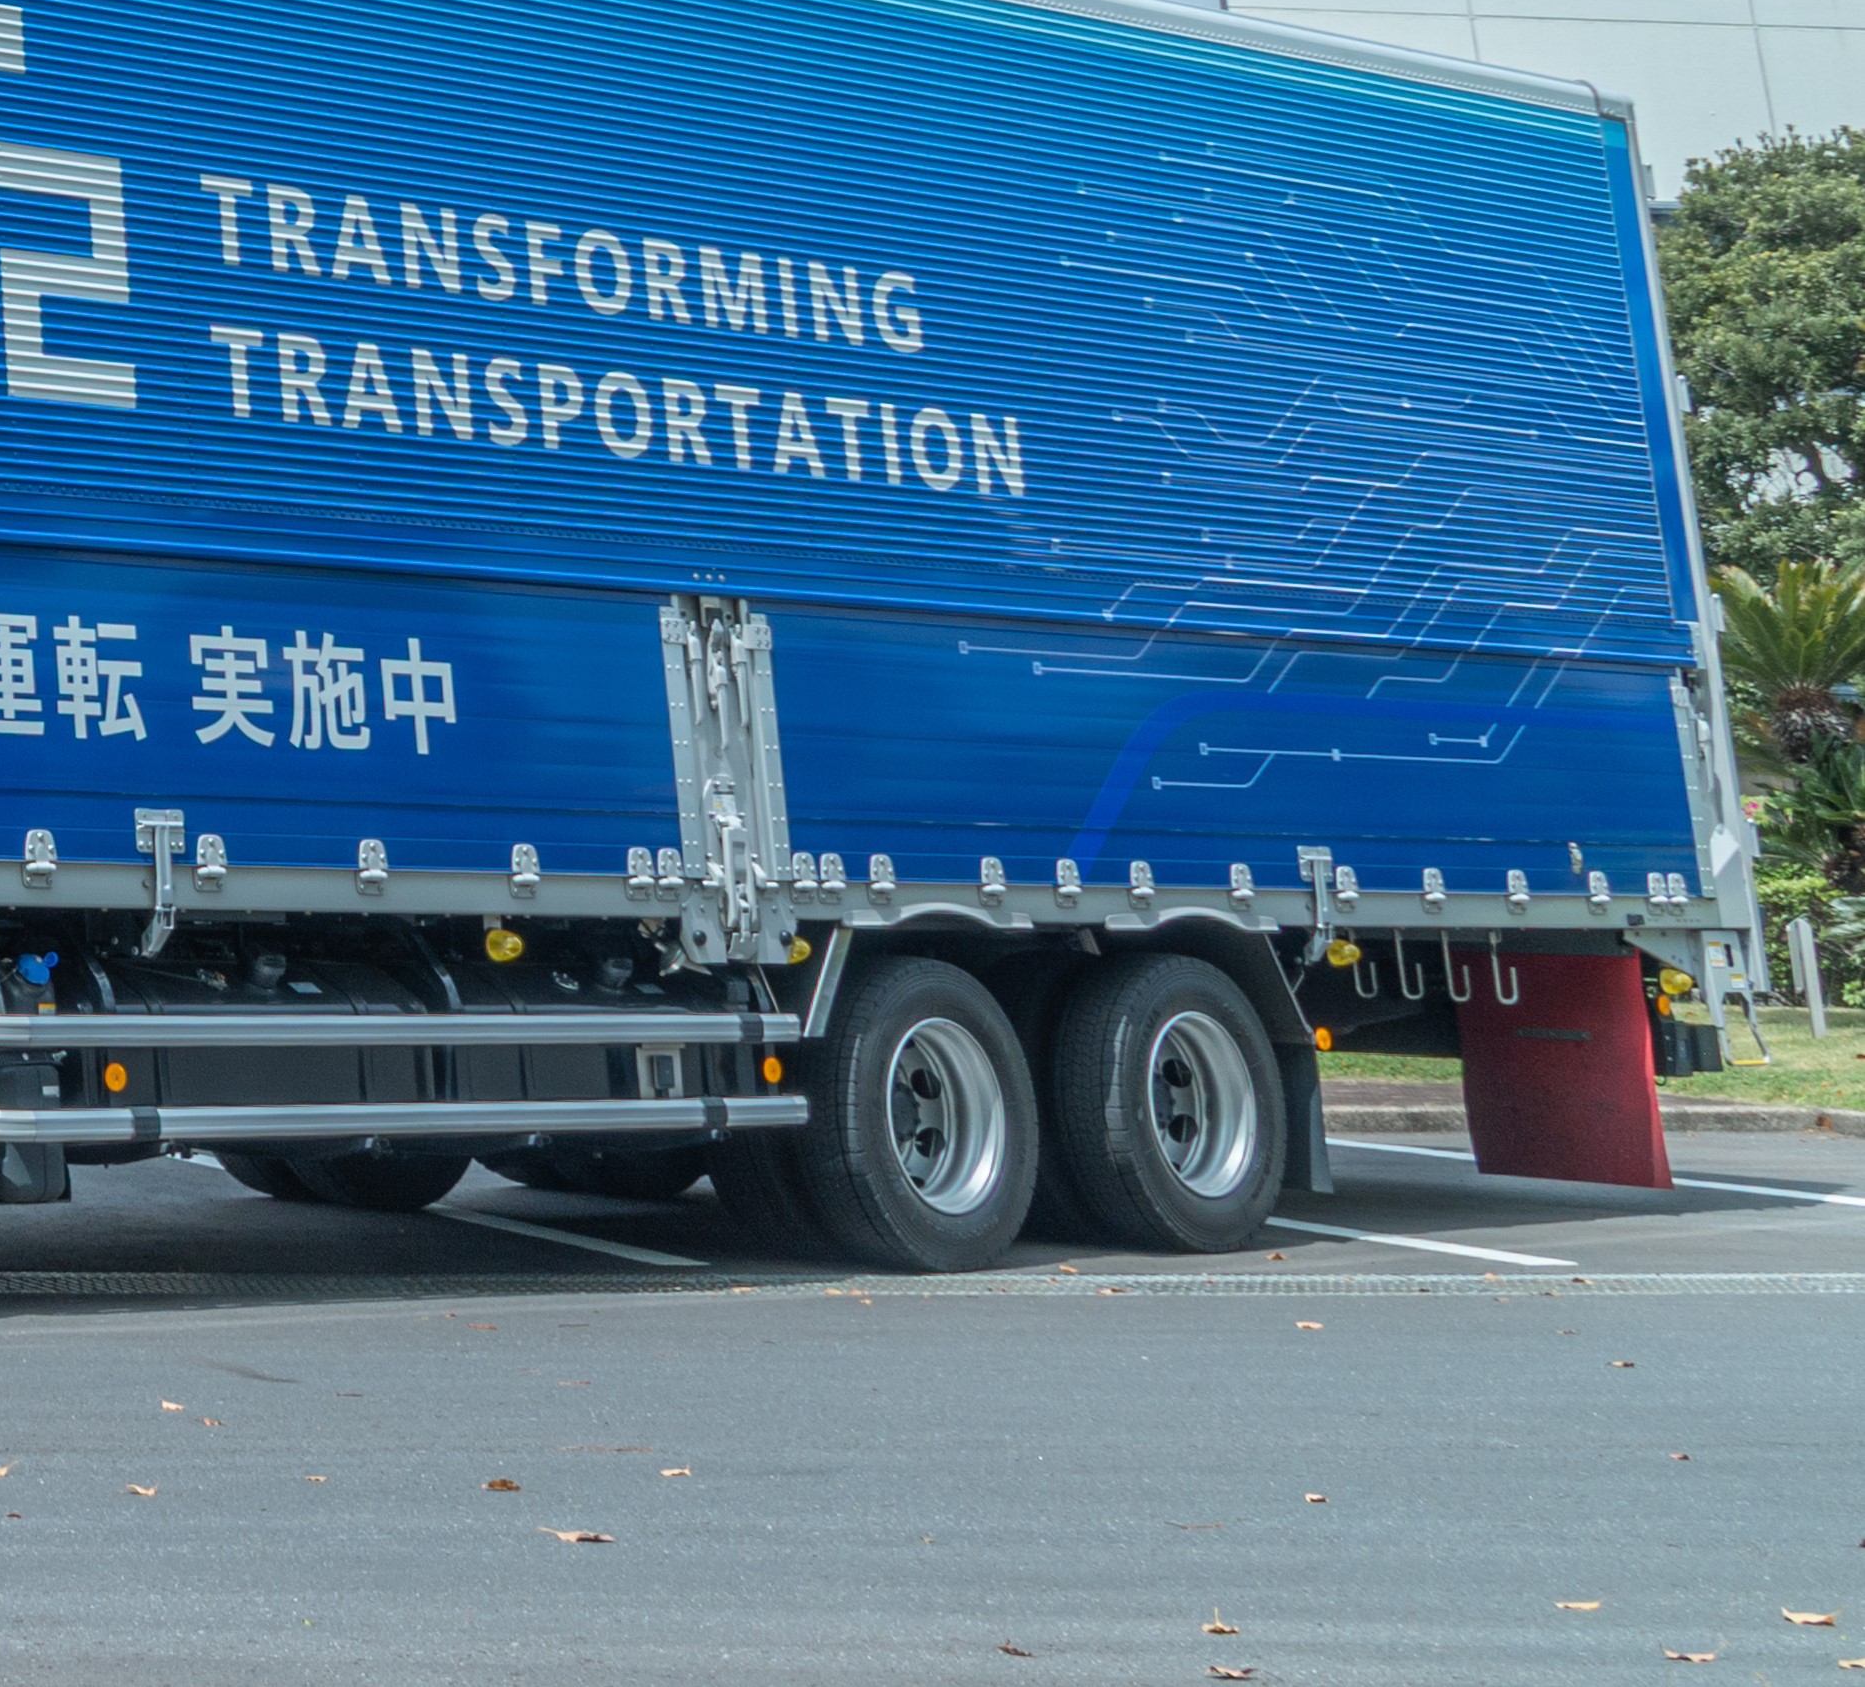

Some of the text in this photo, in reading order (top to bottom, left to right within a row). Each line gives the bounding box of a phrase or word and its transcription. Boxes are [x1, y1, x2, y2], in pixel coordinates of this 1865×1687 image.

[200, 173, 925, 354] TRANSFORMING
[210, 324, 1026, 497] TRANSPORTATION
[189, 625, 457, 755] 実施中
